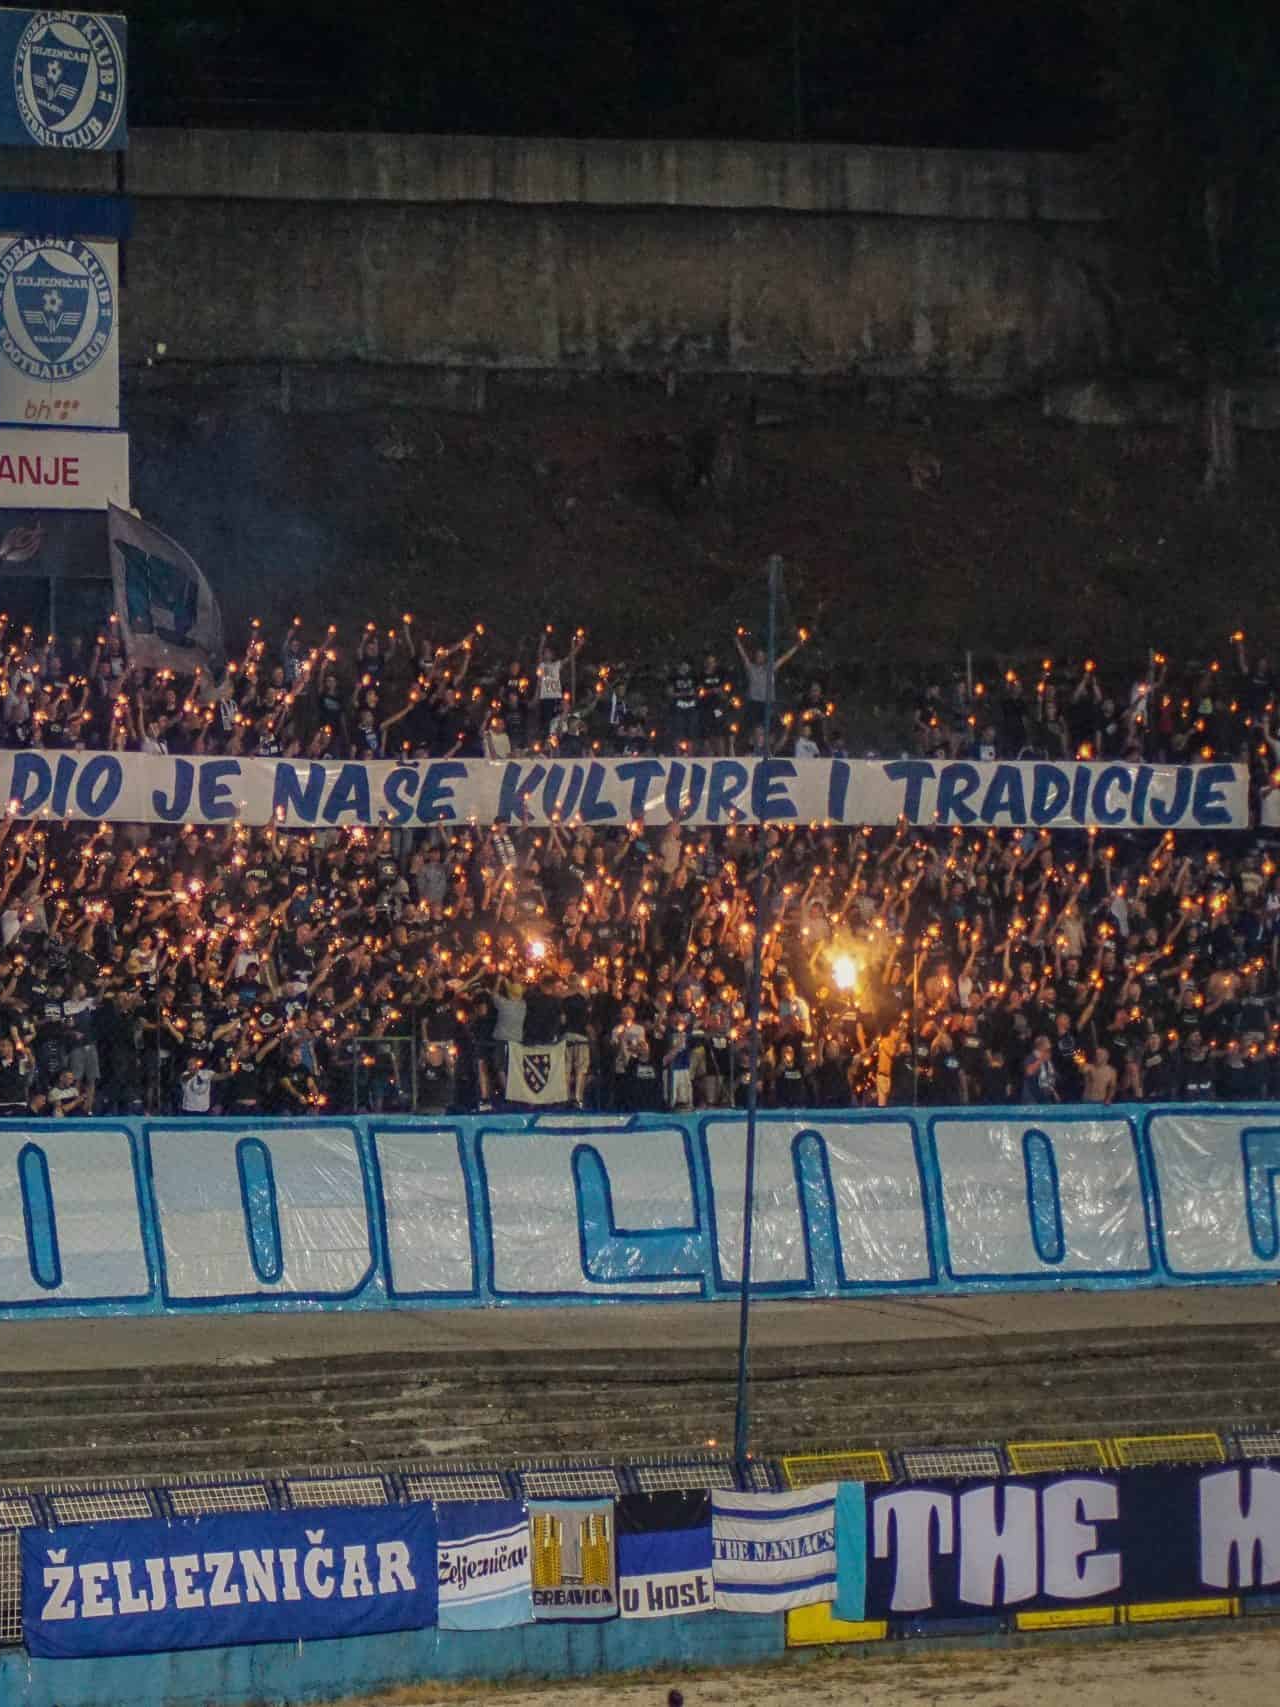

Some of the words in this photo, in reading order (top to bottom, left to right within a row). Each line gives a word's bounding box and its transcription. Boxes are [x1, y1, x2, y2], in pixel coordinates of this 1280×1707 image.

[80, 20, 114, 85] KLUB
[77, 250, 111, 300] KLUB
[72, 331, 109, 373] CLUB
[13, 752, 122, 820] DIO
[151, 758, 244, 823] JE
[271, 759, 468, 827] NAŠE
[497, 760, 798, 826] KULTURE
[827, 759, 851, 820] I
[883, 762, 1237, 828] TRADICIJE
[712, 1539, 749, 1561] THE
[754, 1527, 836, 1562] MANIACS
[873, 1480, 1120, 1611] THE
[40, 1528, 417, 1622] ŽELJEZNIČAR
[532, 1588, 615, 1606] GRBAVICA
